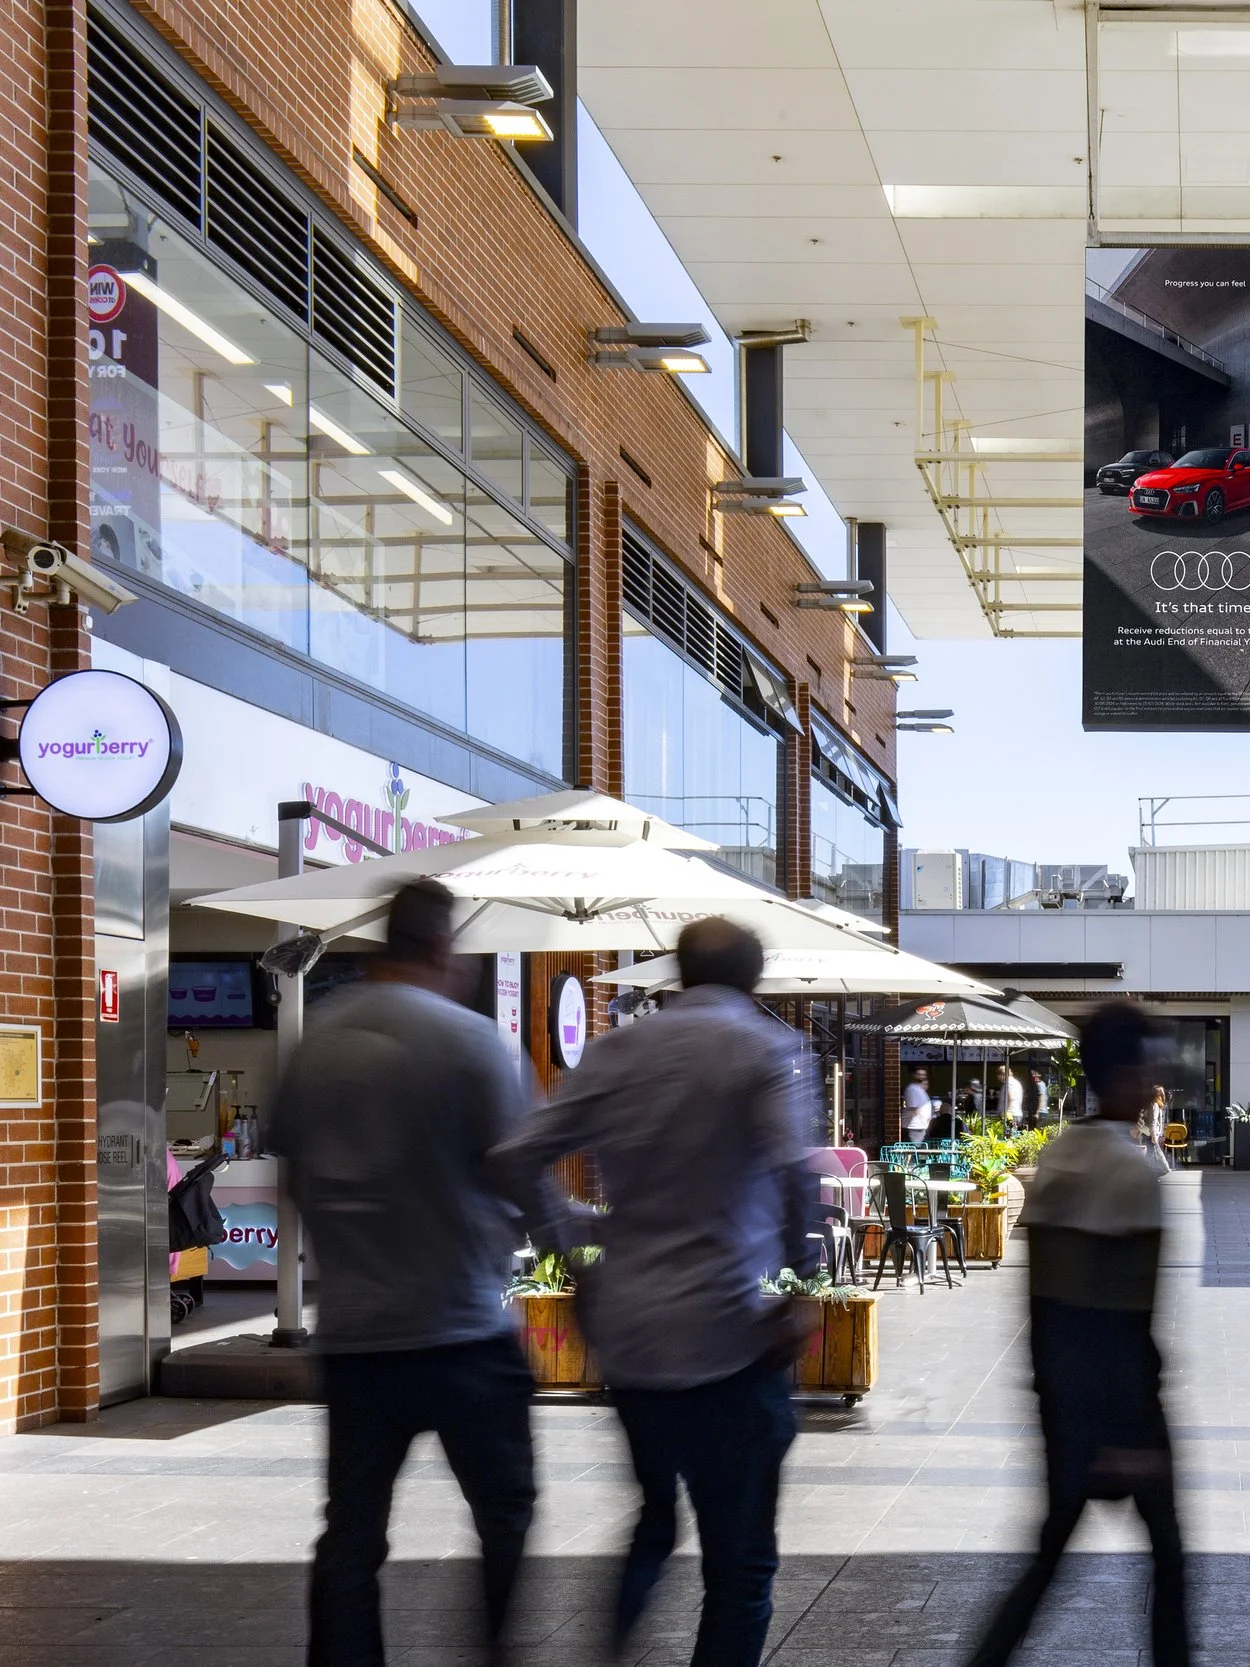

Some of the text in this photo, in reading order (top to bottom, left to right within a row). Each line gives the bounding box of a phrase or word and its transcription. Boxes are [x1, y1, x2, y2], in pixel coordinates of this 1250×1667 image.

[1164, 279, 1199, 289] Progress
[1231, 279, 1247, 288] feel
[1183, 601, 1214, 613] that
[1117, 626, 1153, 635] Receive
[1155, 626, 1205, 635] reductions
[1206, 626, 1234, 637] equal
[1235, 627, 1246, 635] to
[1113, 638, 1124, 646] at
[1126, 637, 1142, 646] the
[1143, 637, 1166, 646] Audi
[1167, 637, 1186, 646] End
[1187, 637, 1199, 646] of
[1200, 637, 1242, 646] Financial
[96, 1151, 112, 1165] OSE
